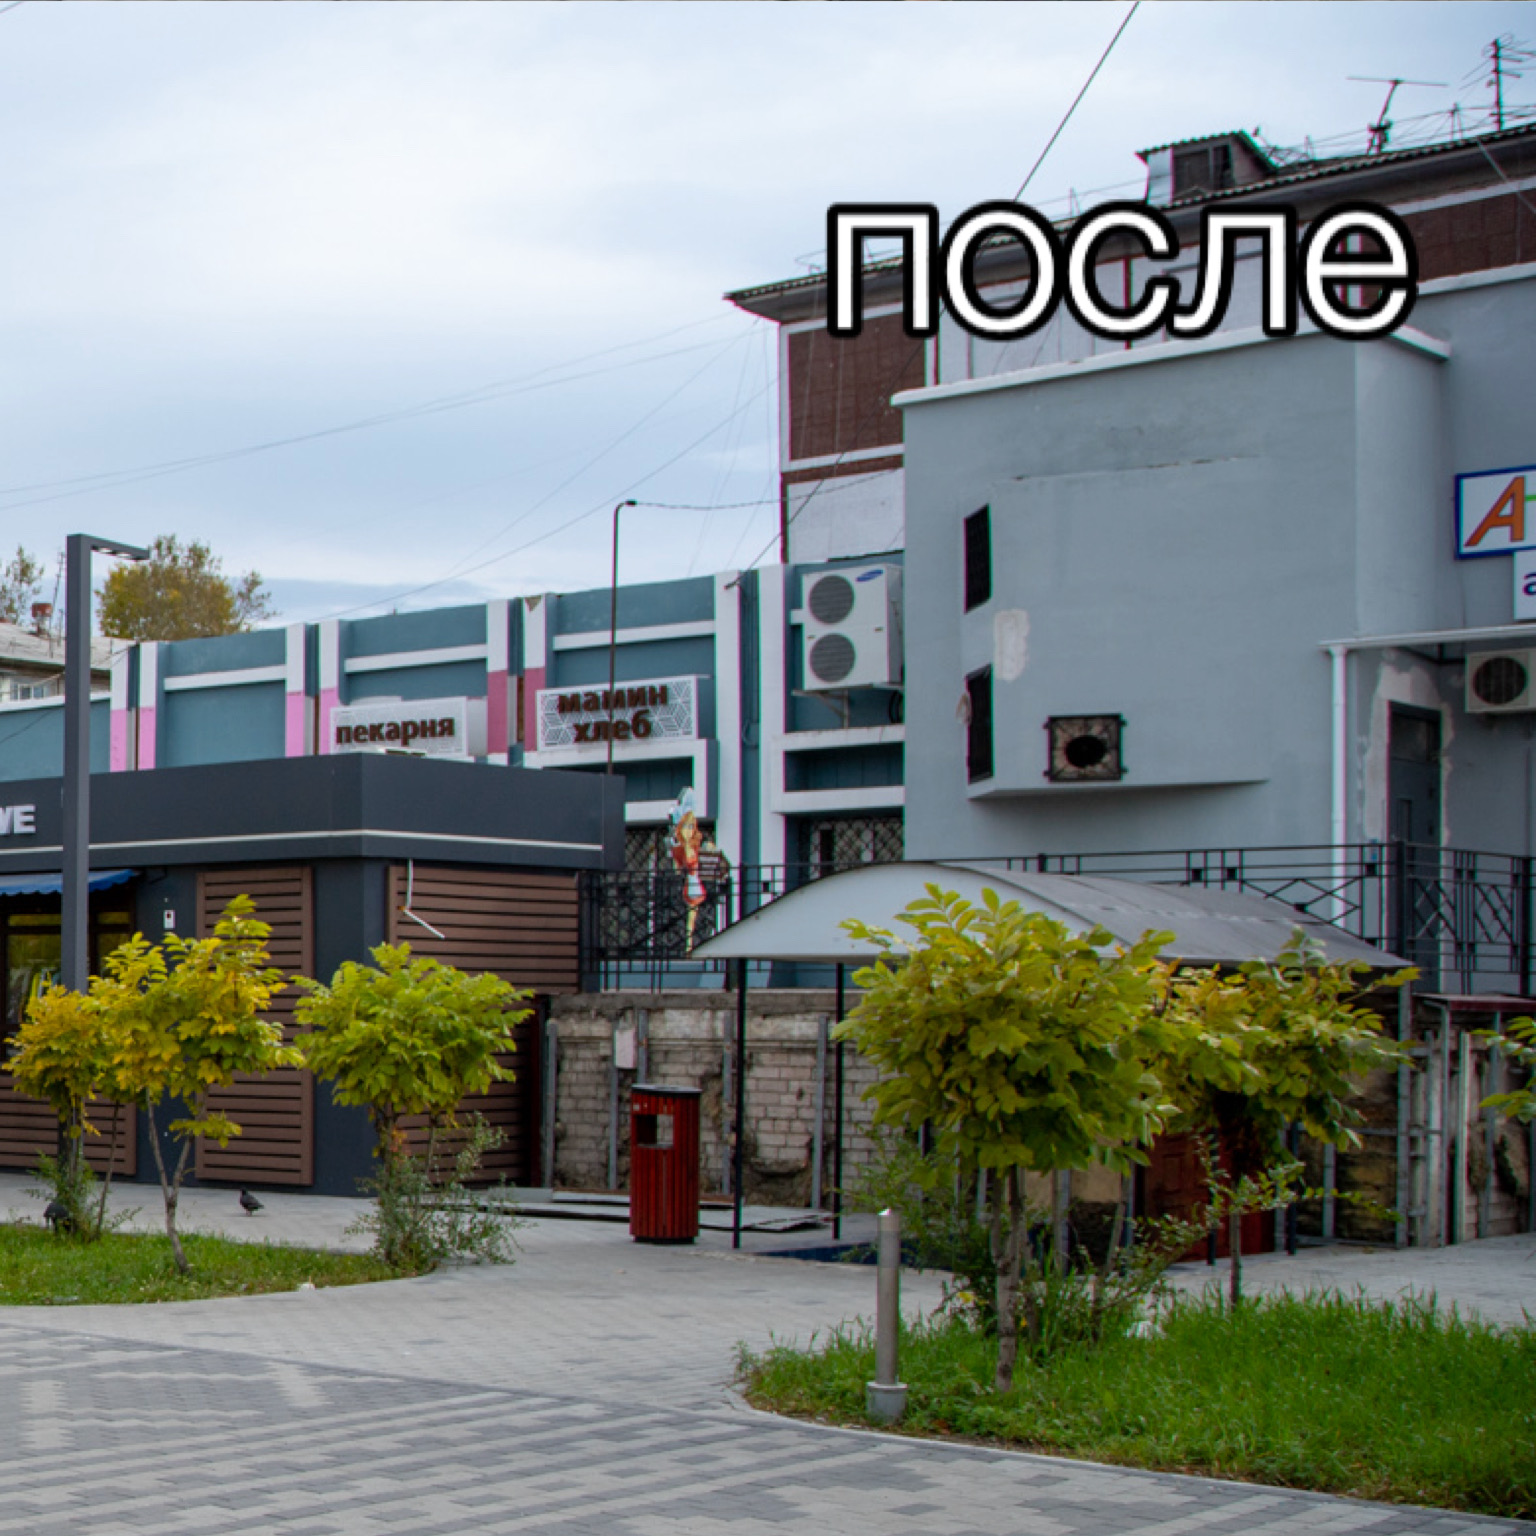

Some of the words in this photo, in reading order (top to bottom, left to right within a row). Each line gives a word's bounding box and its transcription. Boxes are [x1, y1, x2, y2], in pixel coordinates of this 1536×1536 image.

[1463, 475, 1536, 547] А
[557, 684, 668, 714] мамин
[336, 717, 455, 747] пекарня
[573, 709, 652, 743] хлеб
